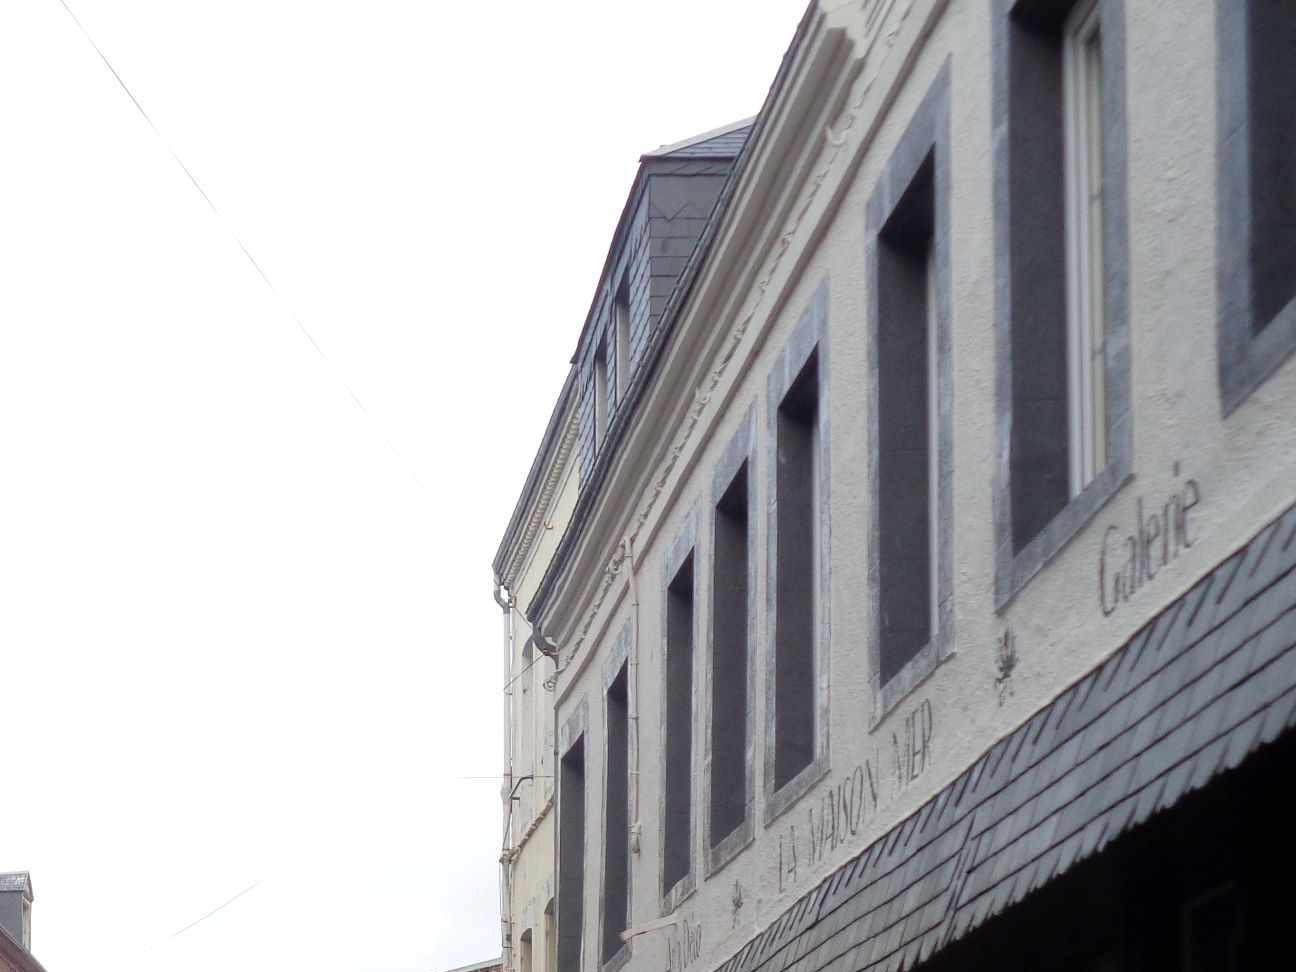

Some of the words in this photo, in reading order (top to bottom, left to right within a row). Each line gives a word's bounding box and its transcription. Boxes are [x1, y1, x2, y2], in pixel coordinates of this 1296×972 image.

[1100, 461, 1200, 618] Galerie
[779, 824, 798, 895] LA
[808, 748, 880, 867] MAISON
[891, 698, 933, 797] MER
